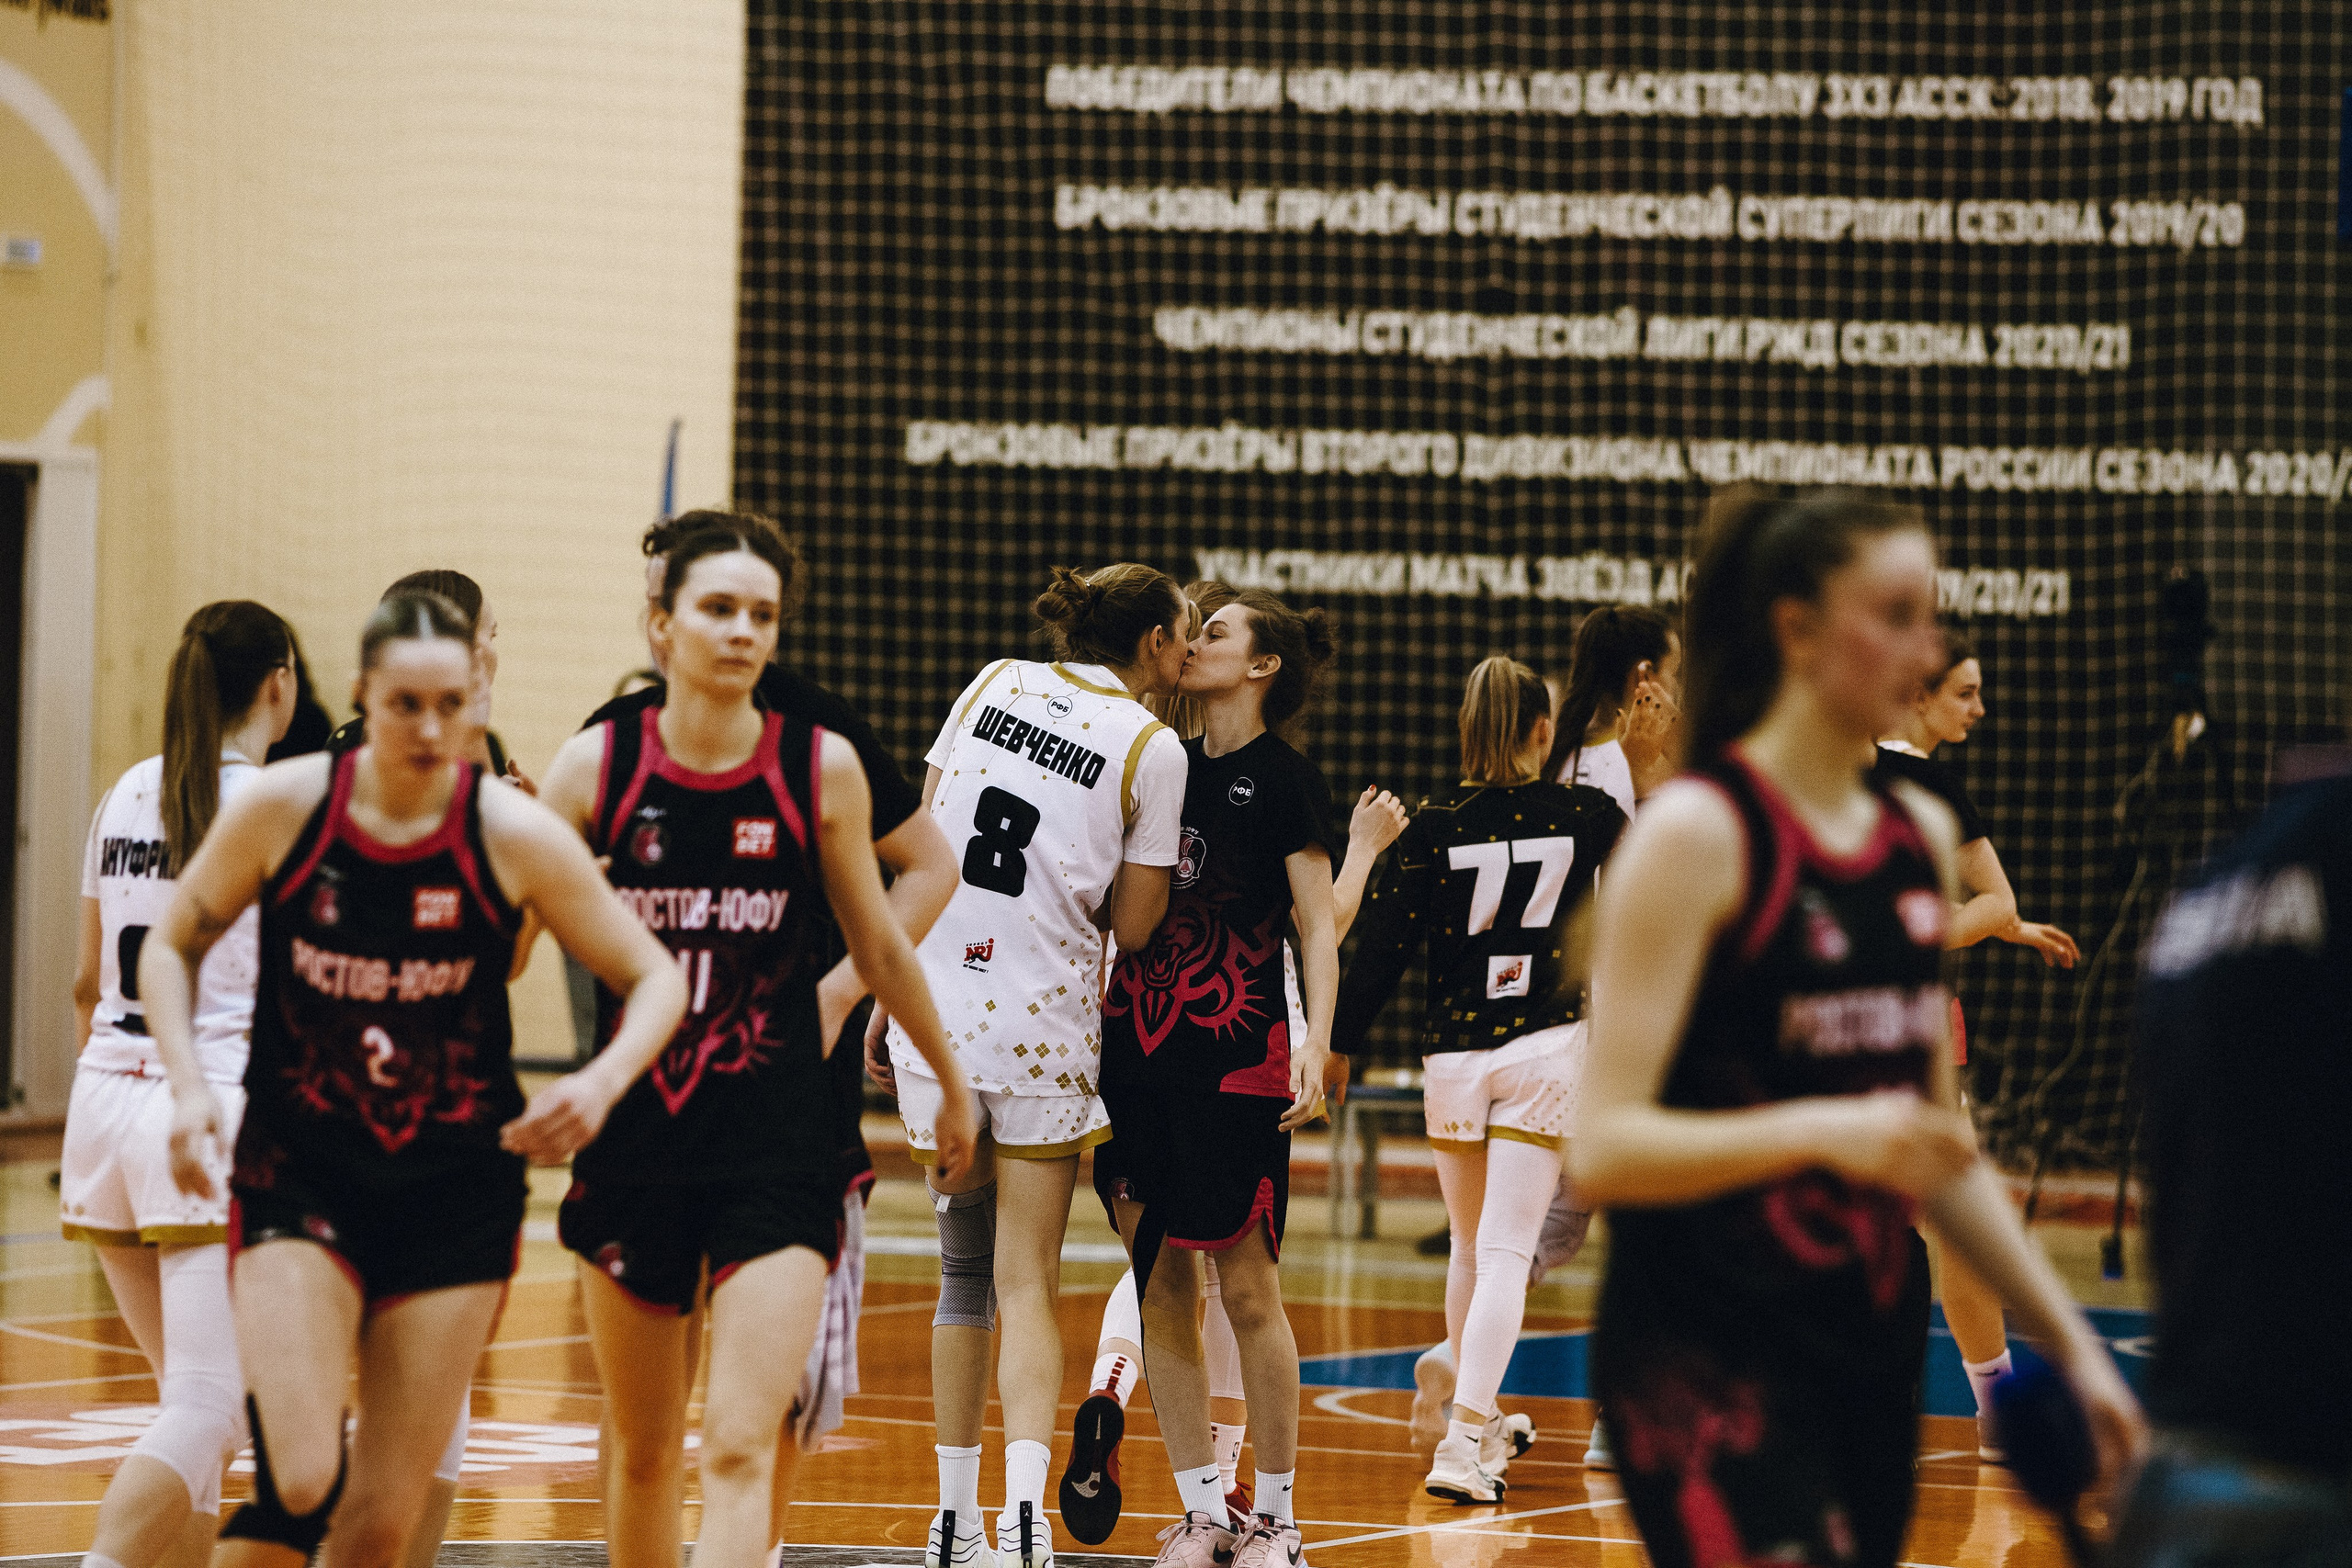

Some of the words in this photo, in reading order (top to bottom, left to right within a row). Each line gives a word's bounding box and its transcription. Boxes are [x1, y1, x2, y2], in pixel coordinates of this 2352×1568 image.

[1046, 64, 1282, 113] ПОБЕДИТЕЛИ
[1285, 68, 1524, 115] ЧЕМПИОНАТА
[1530, 71, 1580, 116] ПО
[1585, 72, 1819, 118] БАСКЕТБОЛУ
[2107, 77, 2188, 121] 2019
[2192, 77, 2264, 129] ГОД
[1055, 185, 1271, 231] БРОНЗОВЫЕ
[1456, 185, 1734, 241] СТУДЕНЧЕСКОЙ
[1738, 195, 1953, 243] СУПЕРЛИГИ
[1957, 198, 2104, 244] СЕЗОНА
[2110, 197, 2245, 253] 2019/20
[1153, 307, 1360, 354] ЧЕМПИОНЫ
[1363, 304, 1639, 364] СТУДЕНЧЕСКОЙ
[1642, 315, 1742, 360] ЛИГИ
[1746, 318, 1836, 370] РЖД
[1841, 321, 1989, 366] СЕЗОНА
[1992, 322, 2131, 375] 2020/21
[905, 422, 1118, 469] БРОНЗОВЫЕ
[1302, 431, 1458, 476] ВТОРОГО
[1461, 434, 1687, 483] ДИВИЗИОНА
[1689, 438, 1936, 487] ЧЕМПИОНАТА
[1939, 445, 2094, 491] РОССИИ
[2096, 447, 2240, 494] СЕЗОНА
[2245, 449, 2352, 505] 2020/
[1193, 548, 1404, 594] УЧАСТНИКИ
[1407, 553, 1532, 600] МАТЧА
[1050, 701, 1069, 713] РФБ
[972, 705, 1107, 790] ШЕВЧЕНКО
[961, 785, 1041, 898] 8
[1448, 837, 1575, 935] 77
[291, 936, 476, 1002] РОСТОВ-ЮФУ
[964, 938, 994, 962] NRJ
[362, 1024, 400, 1088] 2
